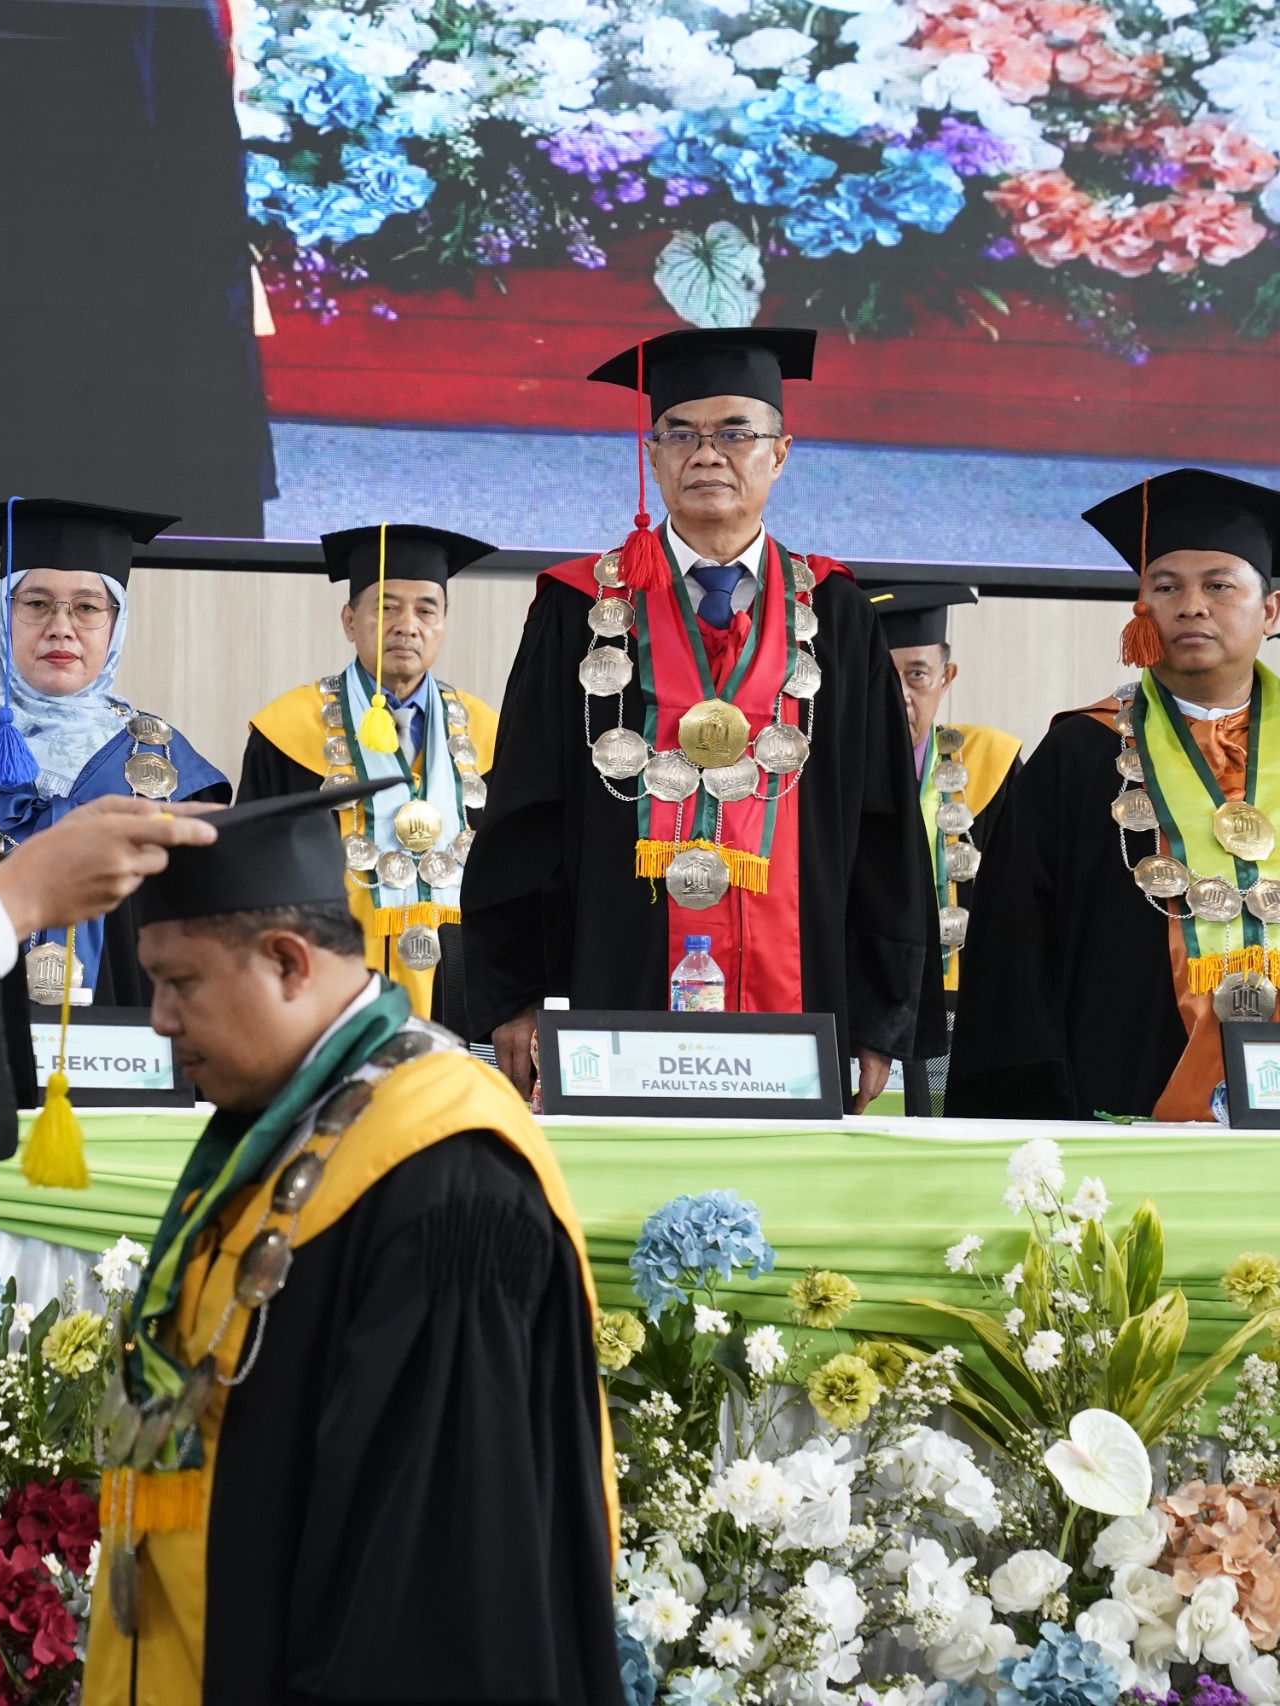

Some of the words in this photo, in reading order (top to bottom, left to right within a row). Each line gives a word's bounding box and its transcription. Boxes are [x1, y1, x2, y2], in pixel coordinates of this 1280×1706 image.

[51, 1055, 147, 1073] REKTOR
[659, 1056, 752, 1076] DEKAN
[642, 1079, 718, 1091] FAKULTAS
[721, 1081, 786, 1092] SYARIAH
